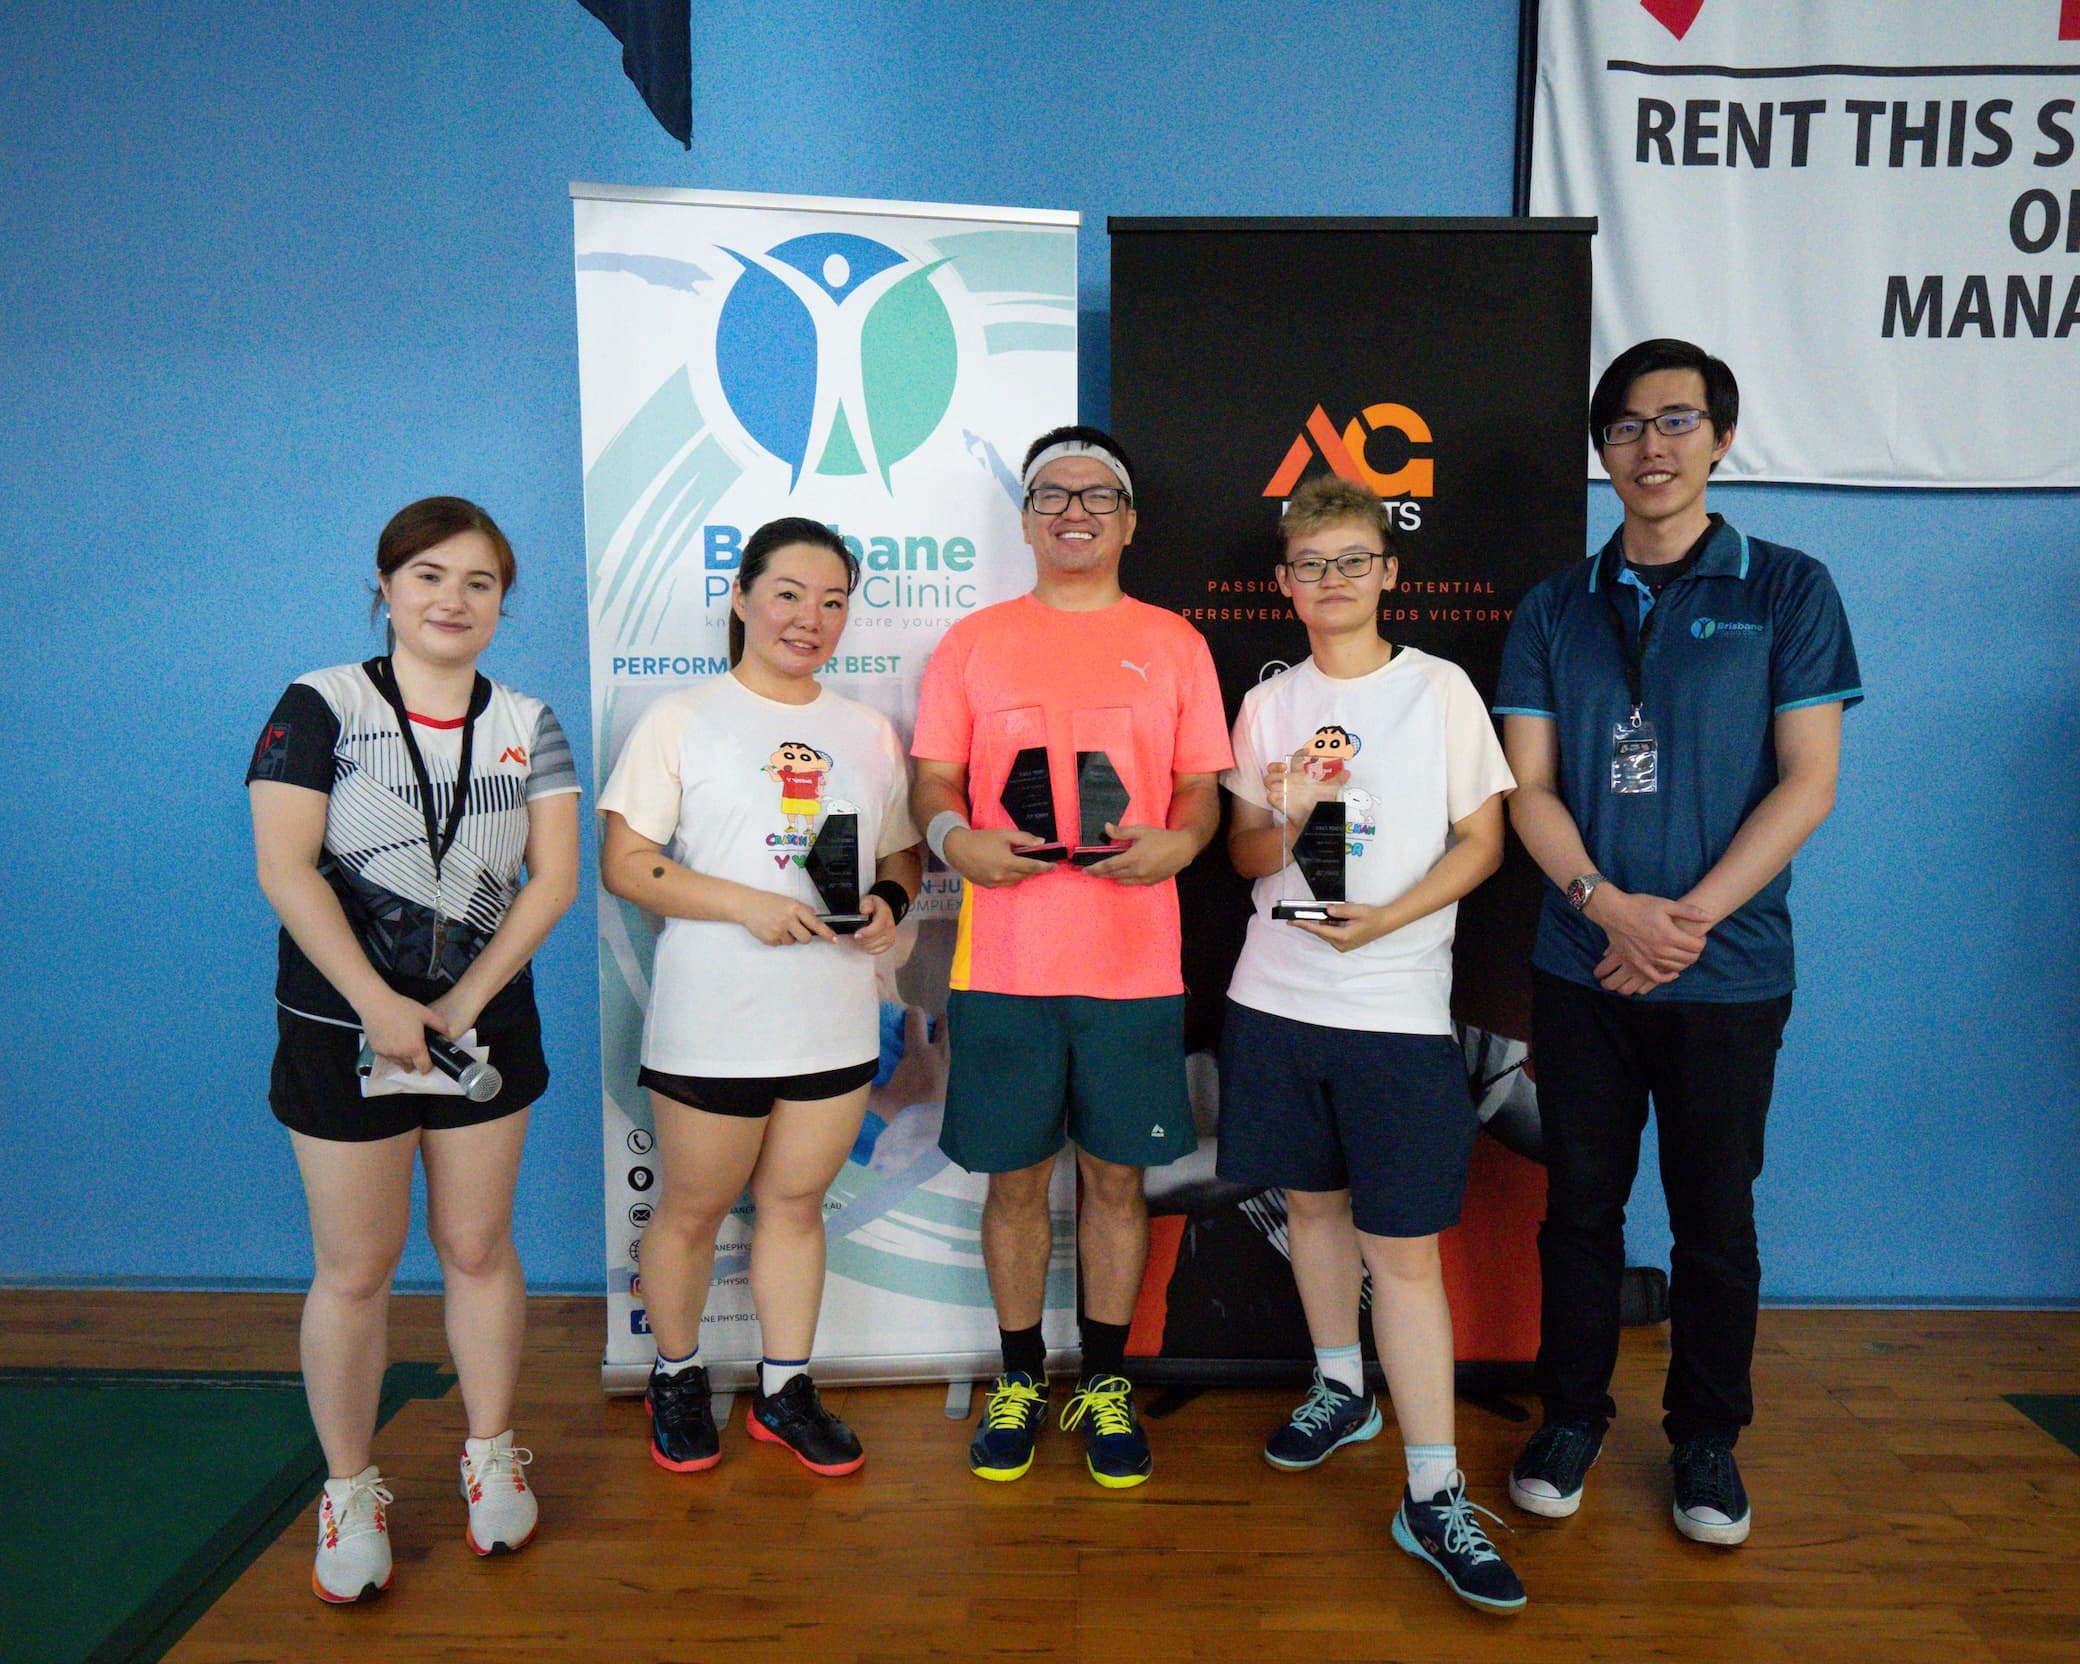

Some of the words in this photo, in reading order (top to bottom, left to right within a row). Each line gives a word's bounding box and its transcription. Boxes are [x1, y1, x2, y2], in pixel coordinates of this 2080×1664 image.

[1636, 97, 1826, 168] RENT
[1845, 99, 2013, 167] THIS
[2033, 98, 2077, 167] S
[1881, 275, 2080, 338] MANA
[703, 524, 977, 572] Bbane
[863, 575, 977, 608] Clinic
[1207, 580, 1279, 593] PASSIO
[1400, 582, 1496, 593] OTENTIAL
[854, 617, 893, 628] care
[1182, 608, 1295, 621] PERSEVERA
[1429, 609, 1513, 621] VICTORY
[845, 656, 902, 673] BEST
